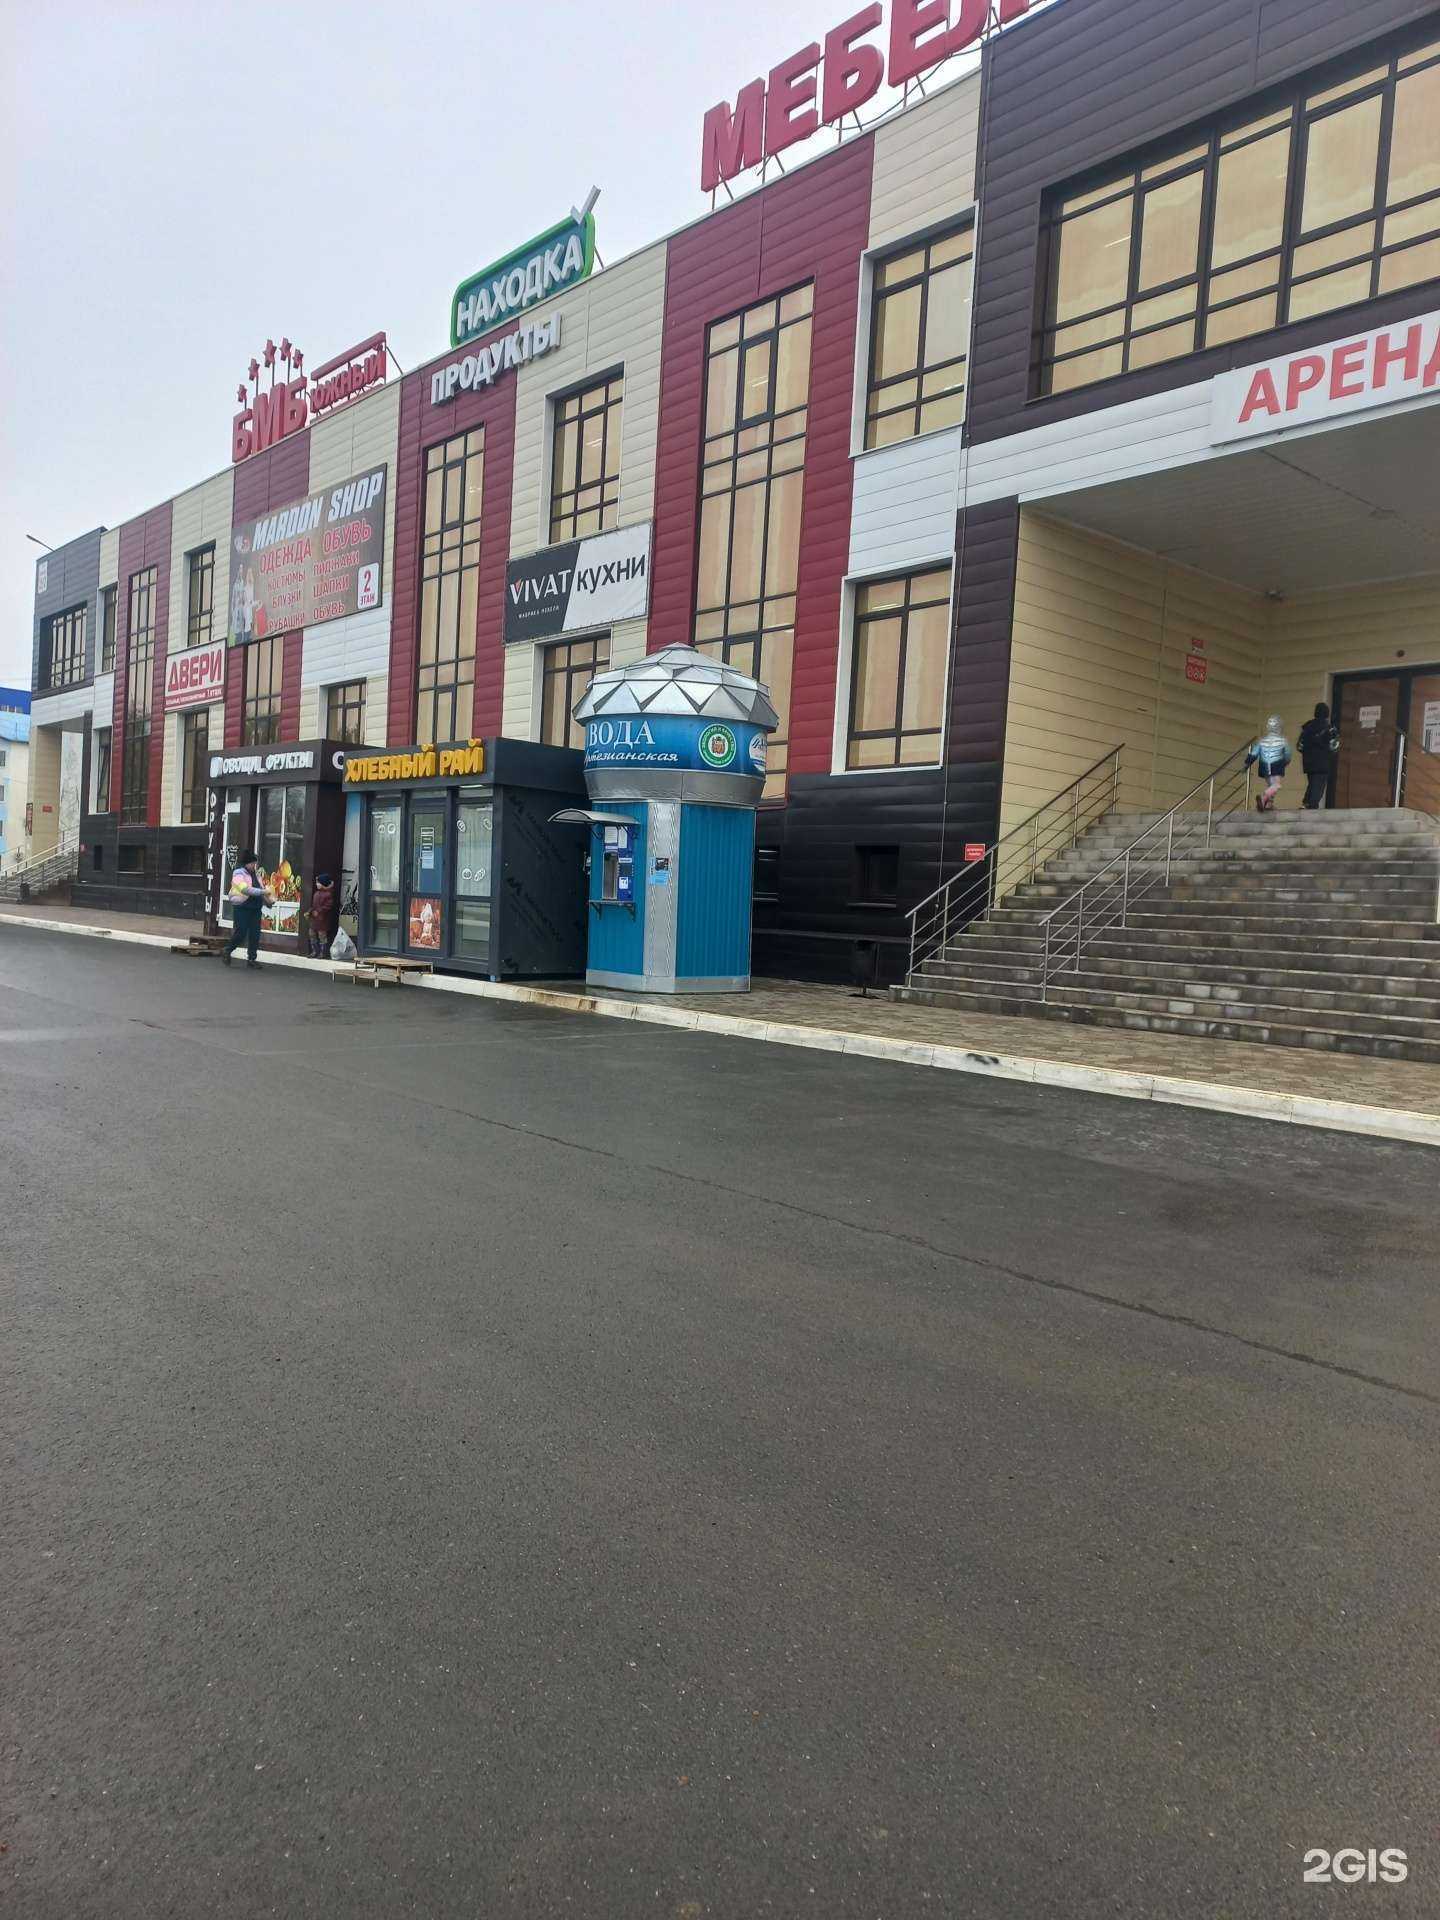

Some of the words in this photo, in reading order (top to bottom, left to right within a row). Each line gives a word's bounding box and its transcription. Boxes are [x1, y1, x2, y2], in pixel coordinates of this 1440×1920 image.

[456, 234, 584, 337] НАХОДКА
[430, 312, 562, 406] ПРОДУКТЫ
[232, 375, 308, 463] БМБ
[310, 342, 387, 413] ЮЖНЫЙ
[328, 471, 384, 522] SHOP
[259, 536, 312, 574] ОДЕЖДА
[323, 518, 372, 554] ОБУВЬ
[313, 574, 350, 599] ШАПКИ
[363, 569, 372, 593] 2
[510, 568, 573, 604] VIVAT
[576, 553, 646, 594] КУХНИ
[268, 612, 305, 634] РУБАШКИ
[313, 601, 345, 621] ОБУВЬ
[360, 593, 376, 606] ЭТАЖ
[168, 649, 222, 693] ДВЕРИ
[589, 720, 656, 750] ВОДА
[265, 751, 314, 771] ФРУКТЫ
[344, 743, 436, 782] ХЛЕБНЫЙ
[440, 738, 484, 775] РАЙ
[204, 791, 217, 913] ФРУКТЫ
